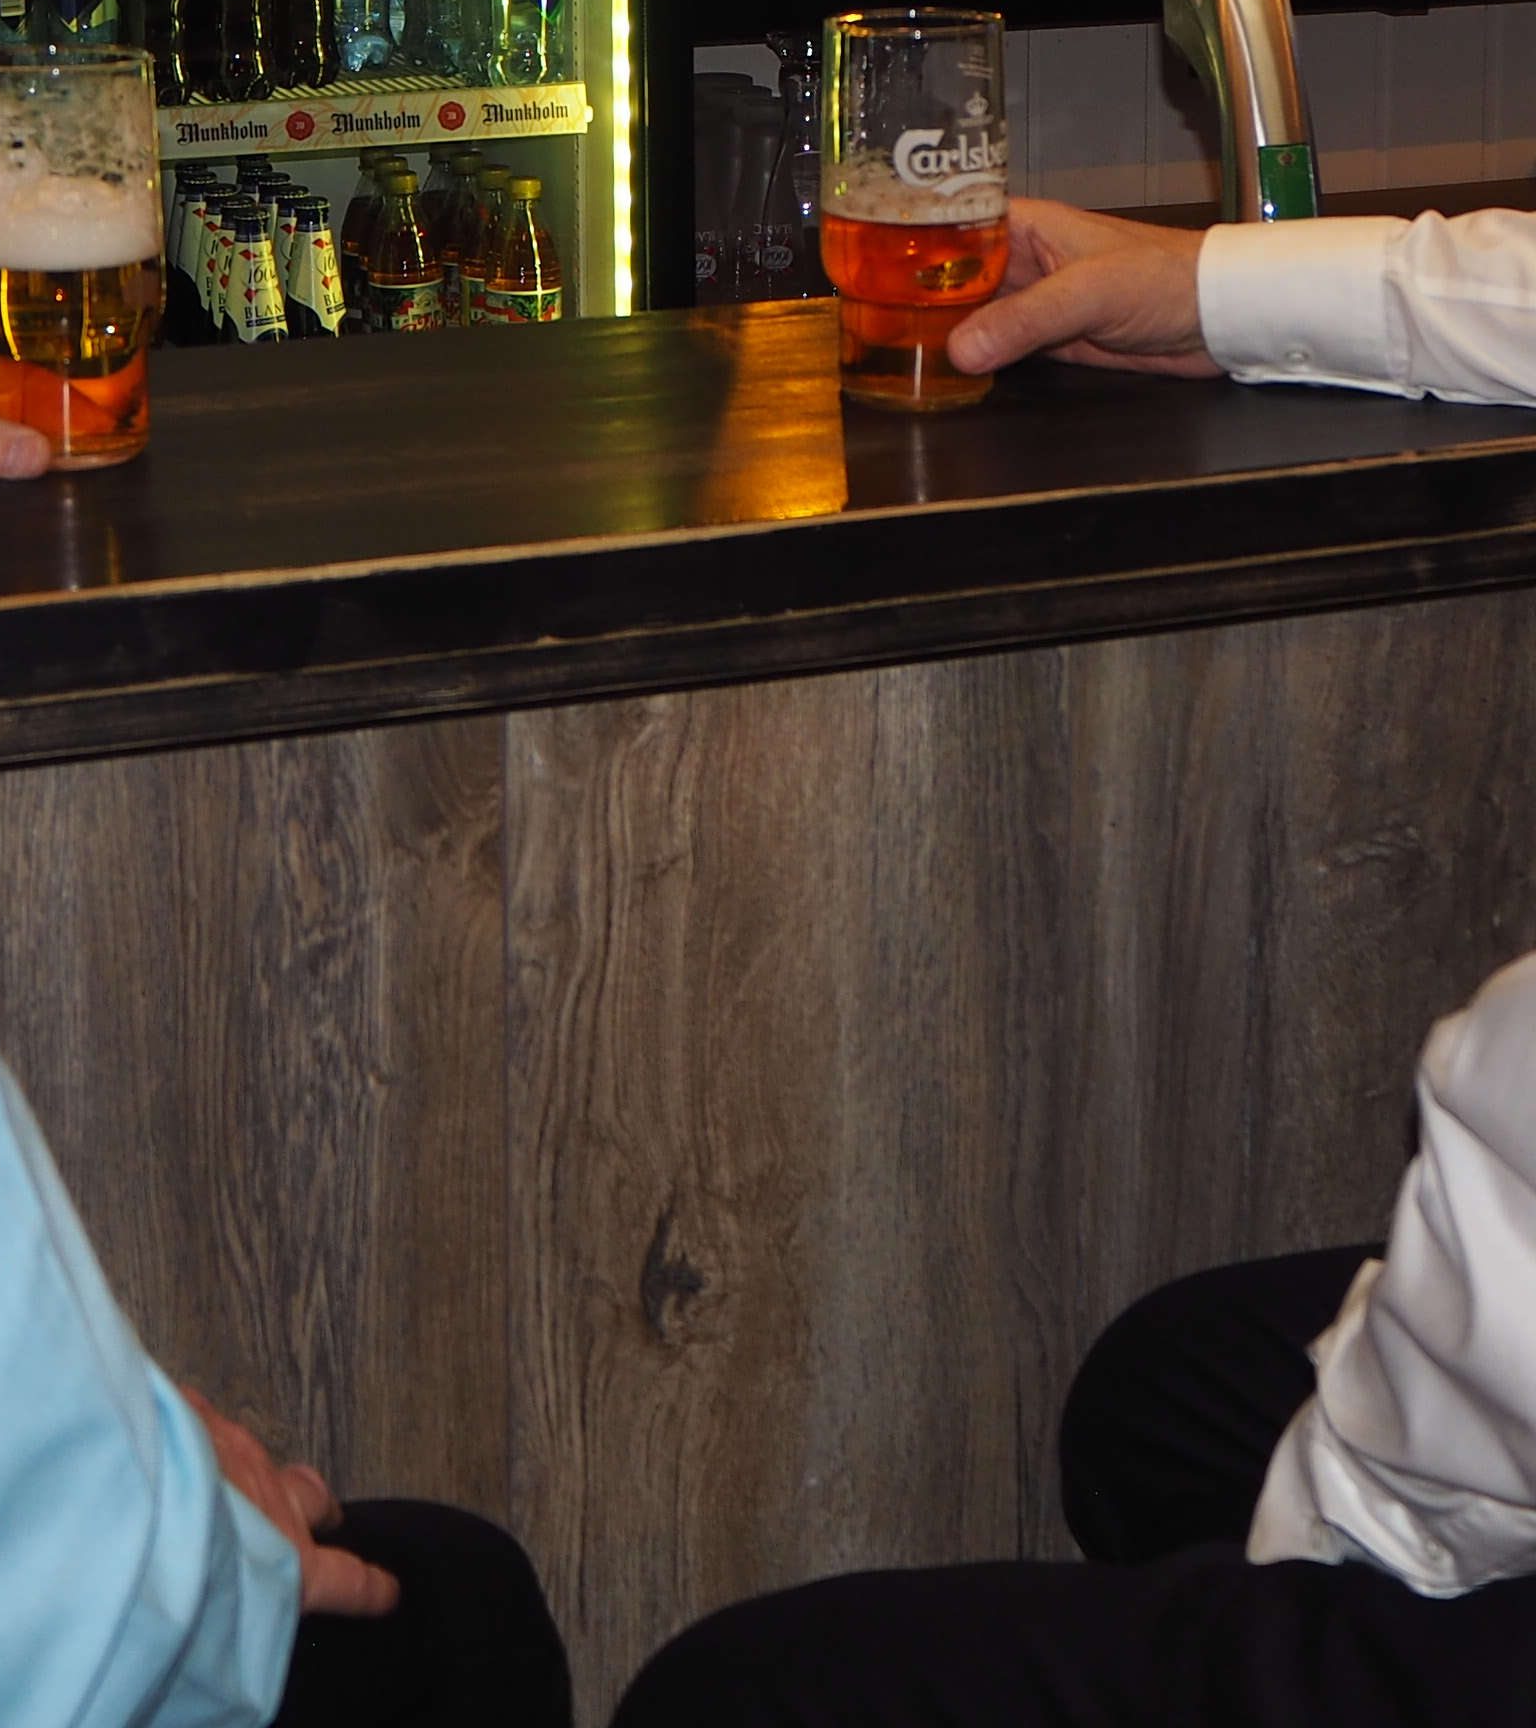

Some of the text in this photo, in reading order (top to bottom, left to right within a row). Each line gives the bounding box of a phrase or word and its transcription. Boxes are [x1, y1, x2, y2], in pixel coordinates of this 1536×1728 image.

[331, 110, 421, 135] Munkholm
[481, 101, 569, 126] Munkholm
[176, 119, 269, 146] Munkholm
